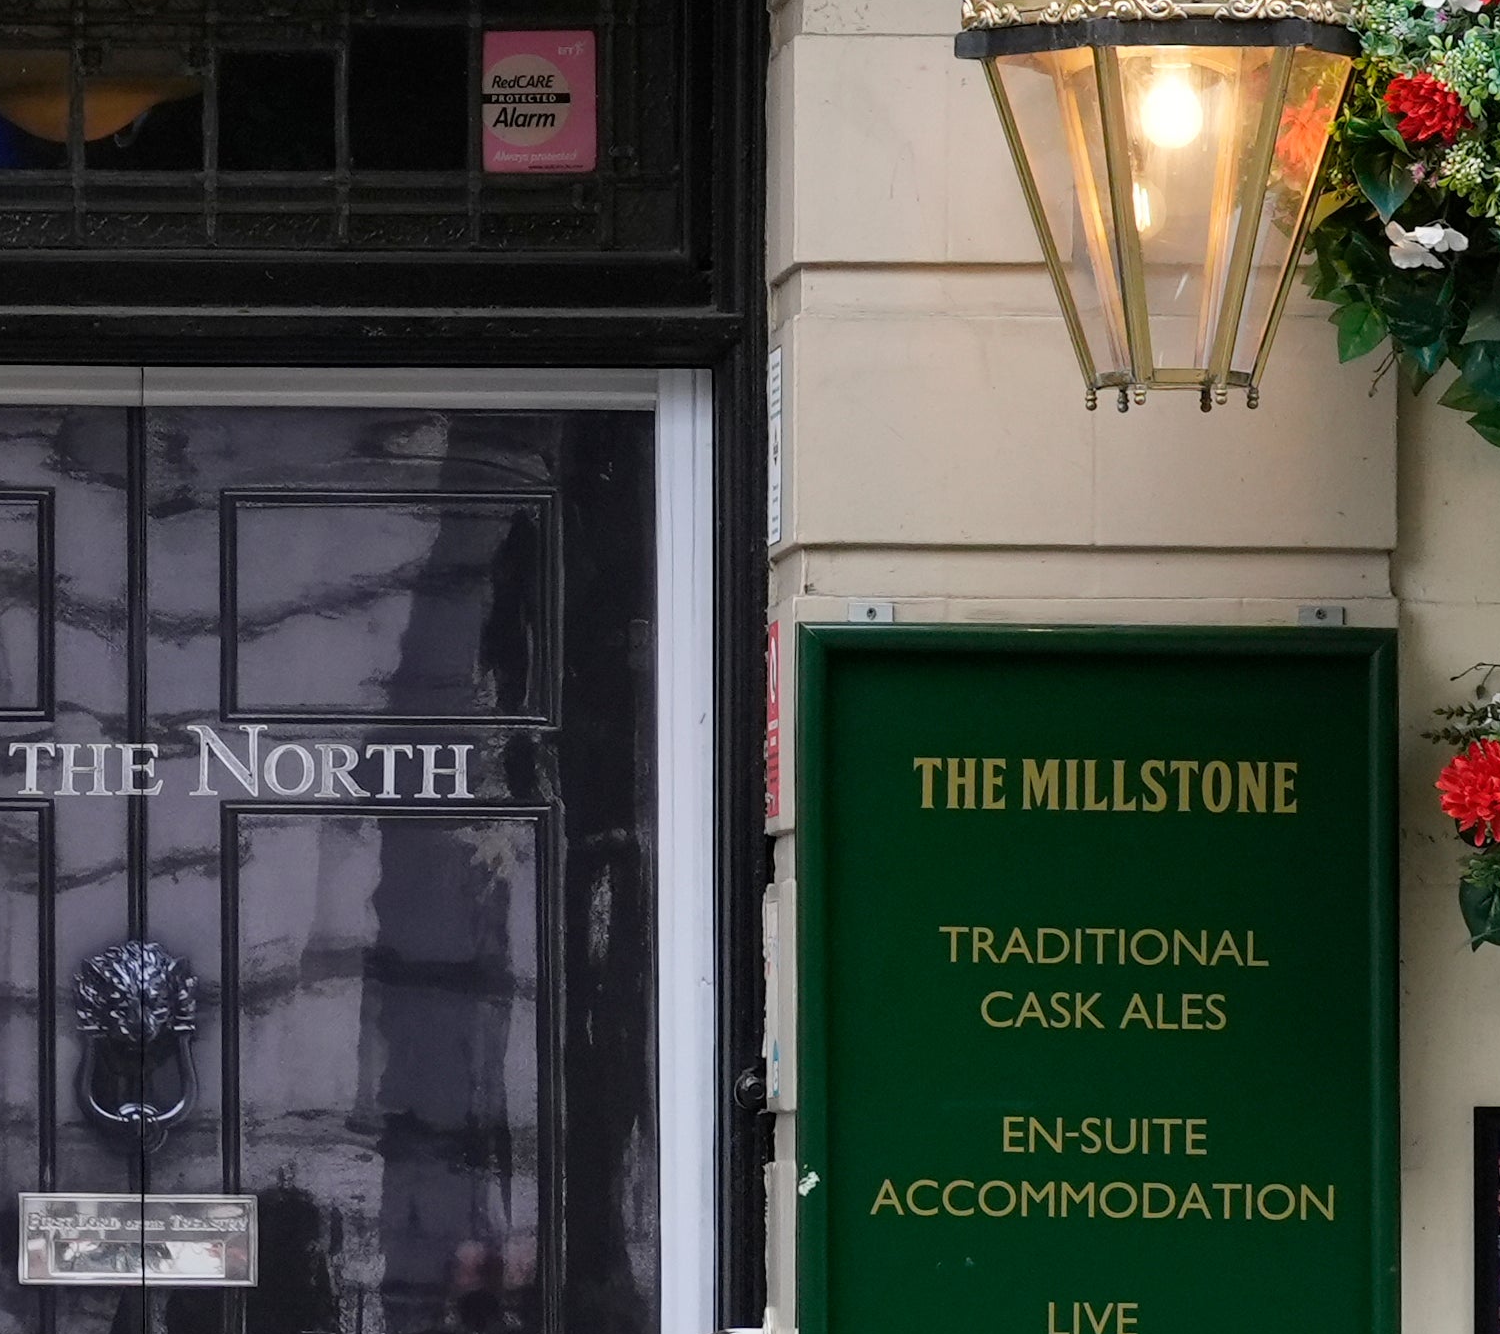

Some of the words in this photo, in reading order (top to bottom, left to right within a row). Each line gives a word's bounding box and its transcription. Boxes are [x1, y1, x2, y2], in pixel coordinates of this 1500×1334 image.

[491, 74, 555, 89] RedCARE
[491, 94, 557, 103] PROTECTED
[492, 106, 556, 128] Alarm
[9, 742, 163, 798] THE
[187, 723, 475, 799] NORTH
[913, 756, 1007, 810] THE
[1022, 758, 1298, 814] MILLSTONE
[938, 925, 1270, 967] TRADITIONAL
[980, 990, 1105, 1029] CASK
[1119, 992, 1227, 1031] ALES
[1002, 1116, 1208, 1156] EN-SUITE
[870, 1178, 1335, 1221] ACCOMMODATION
